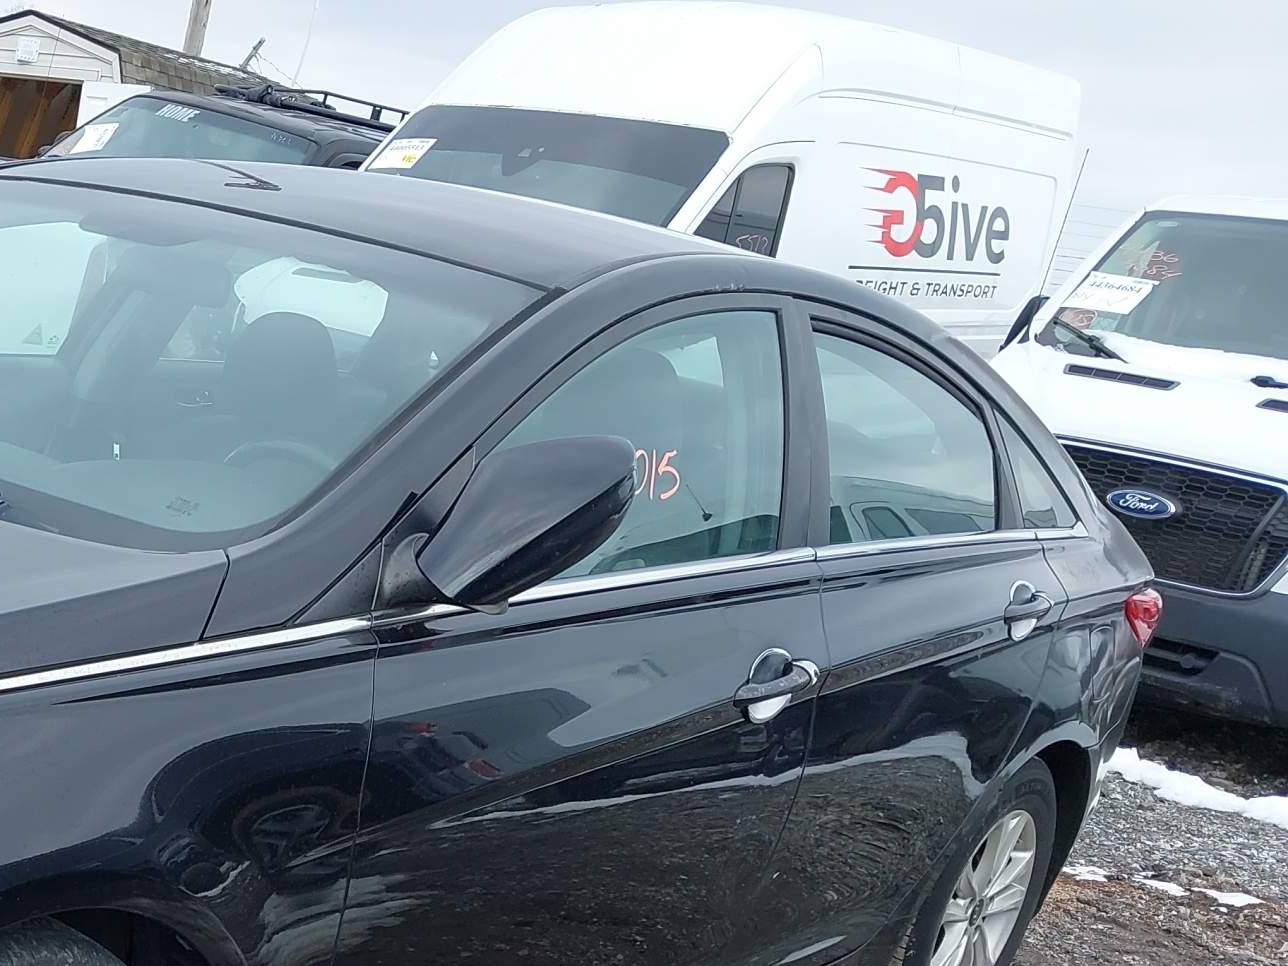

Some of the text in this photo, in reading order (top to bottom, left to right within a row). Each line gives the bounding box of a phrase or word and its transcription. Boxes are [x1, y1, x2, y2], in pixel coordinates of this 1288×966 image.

[155, 103, 201, 122] HOME
[909, 281, 921, 297] &
[924, 282, 998, 299] TRANSPORT
[1119, 493, 1160, 513] Ford
